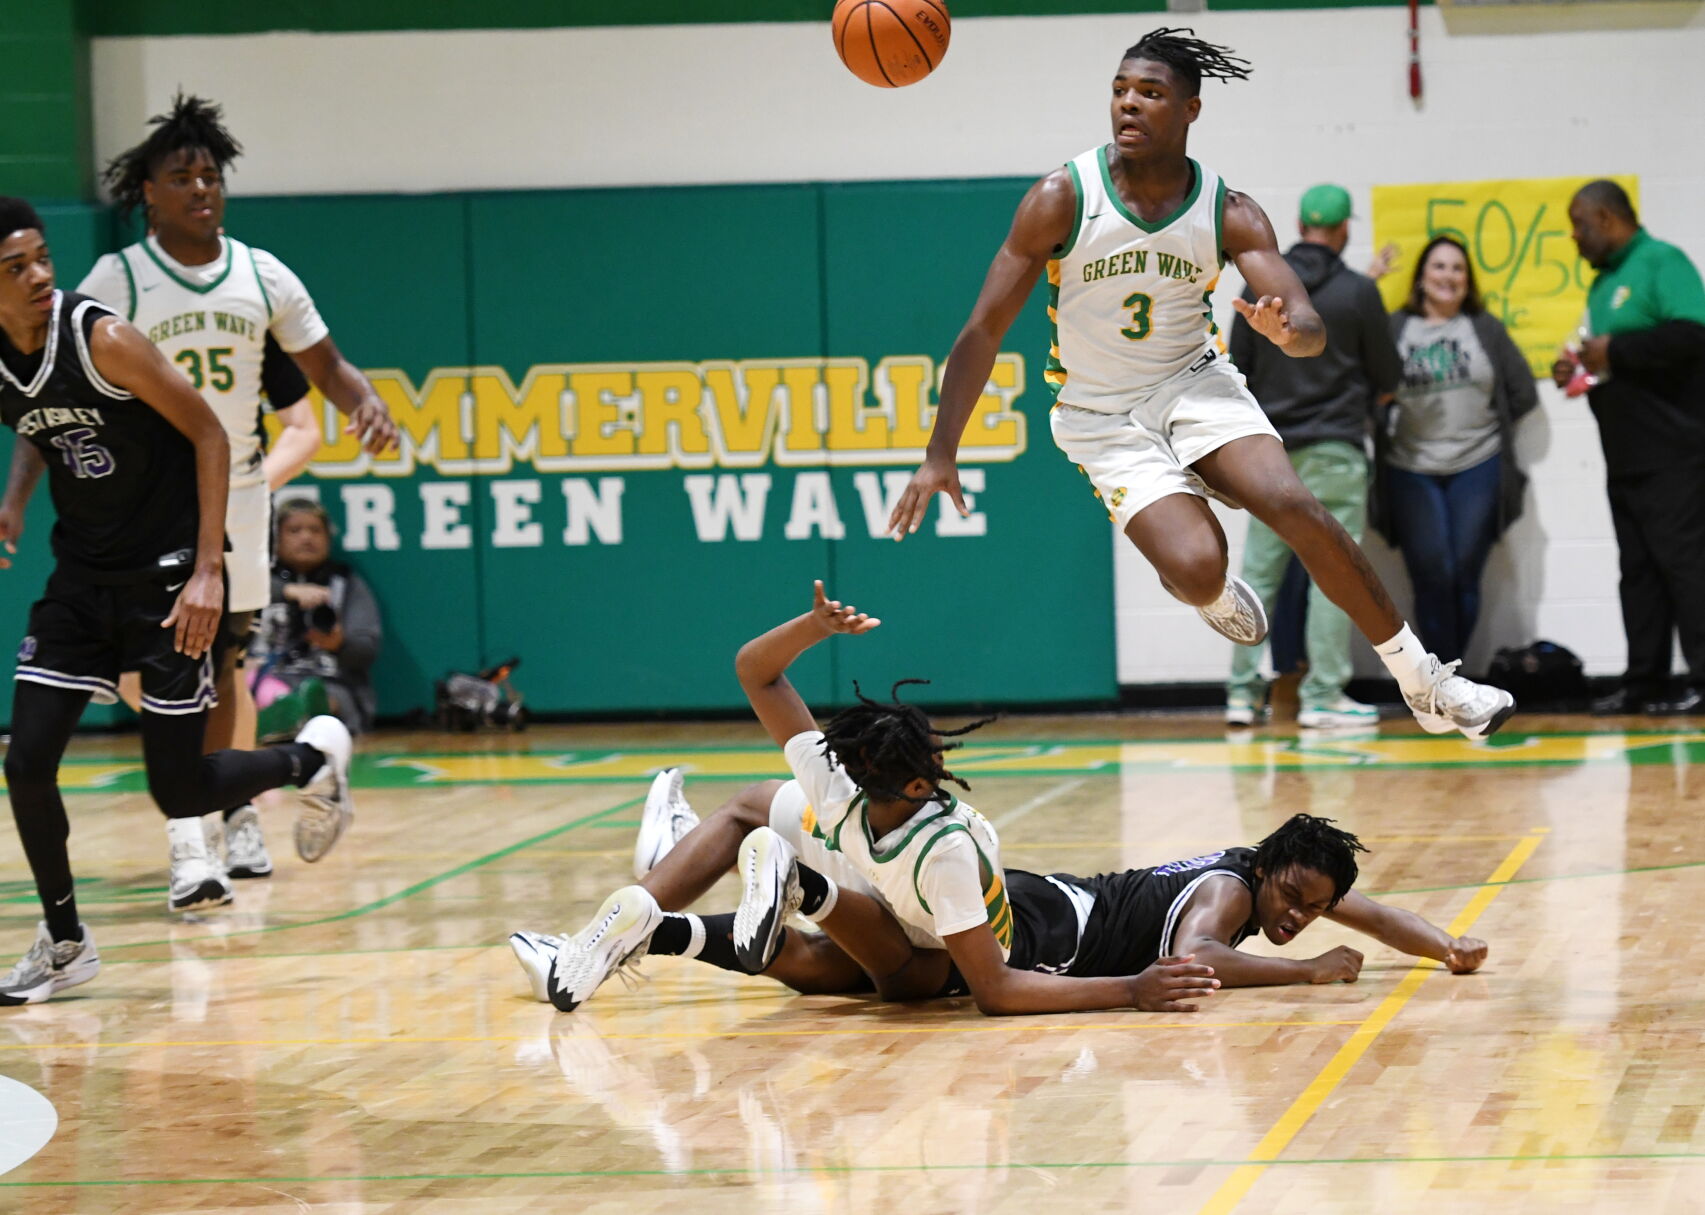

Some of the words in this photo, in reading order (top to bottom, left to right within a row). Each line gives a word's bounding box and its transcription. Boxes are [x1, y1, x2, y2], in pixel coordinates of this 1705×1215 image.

[1083, 250, 1148, 283] GREEN
[1156, 251, 1203, 284] WAVE
[149, 311, 206, 344] GREEN
[213, 311, 256, 342] WAVE
[1120, 291, 1155, 341] 3
[174, 346, 236, 394] 35
[262, 353, 1027, 478] UMMERVILLE
[51, 427, 116, 479] 15
[274, 477, 625, 551] REEN
[684, 468, 988, 542] WAVE
